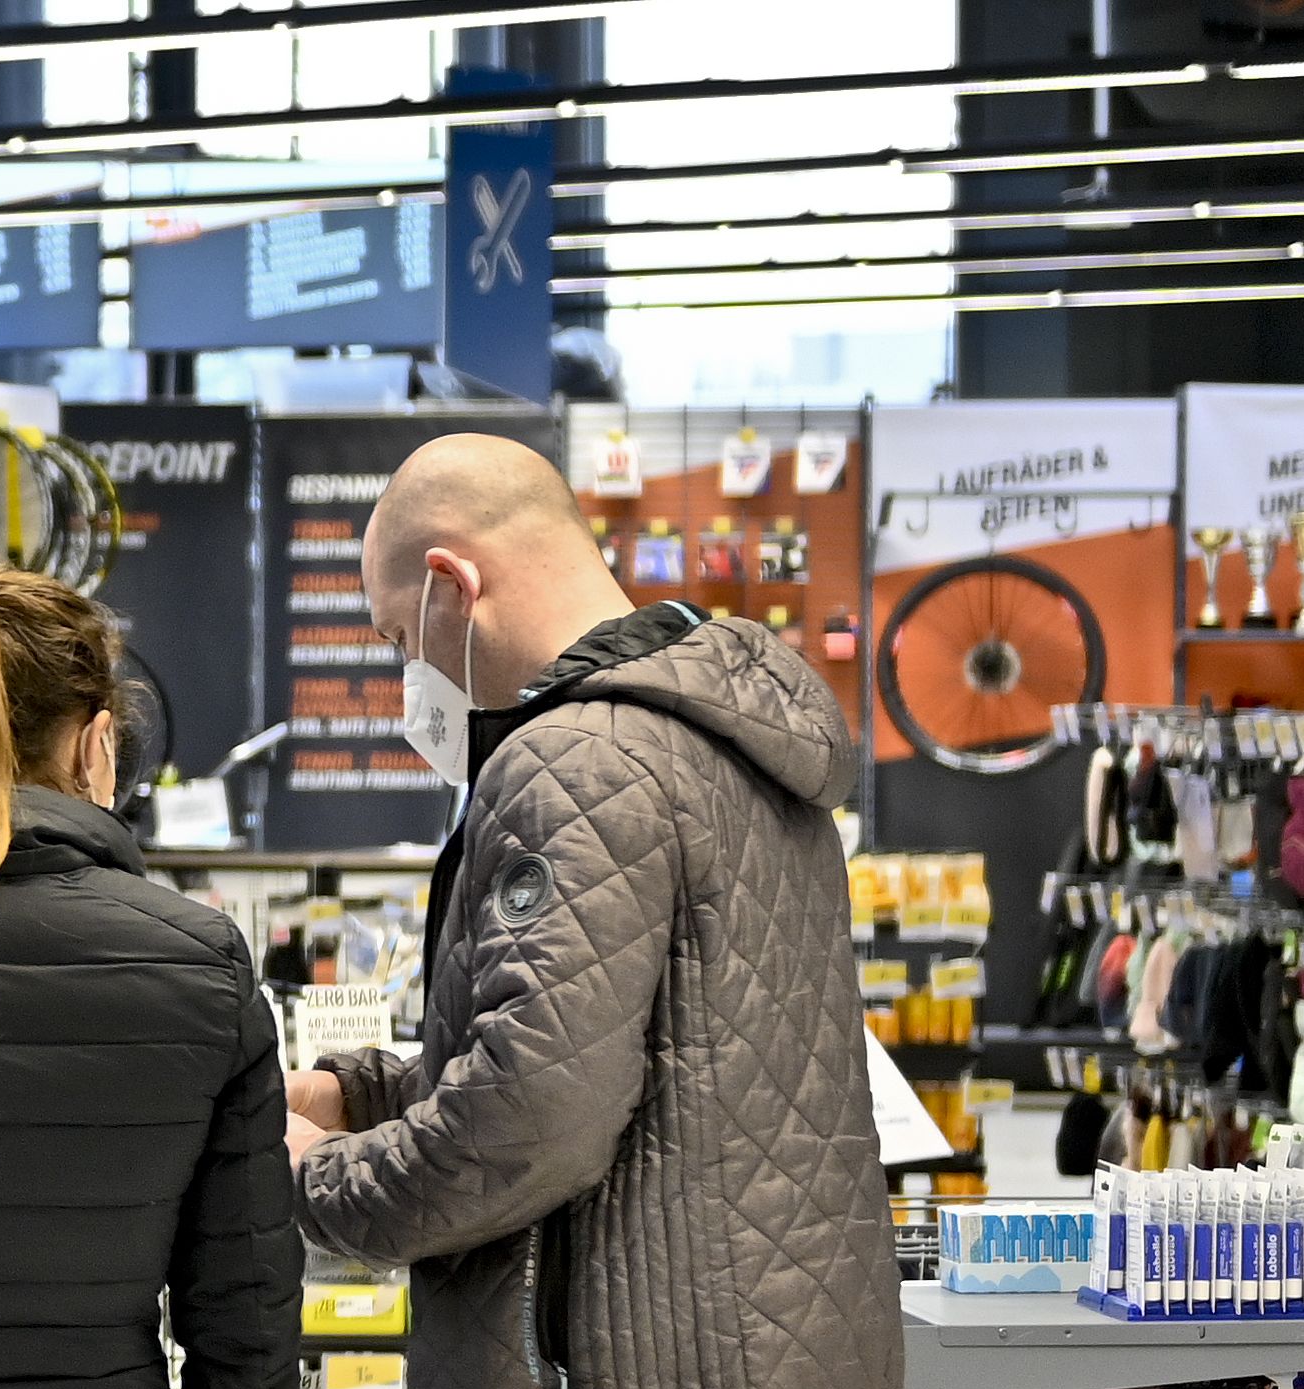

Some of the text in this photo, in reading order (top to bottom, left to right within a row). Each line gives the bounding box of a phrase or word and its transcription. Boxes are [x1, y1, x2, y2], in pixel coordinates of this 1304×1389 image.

[938, 446, 1109, 497] LAUFRÄDER &
[348, 988, 379, 1007] BAR
[333, 1016, 381, 1028] PROTEIN
[1267, 1233, 1278, 1279] Labello
